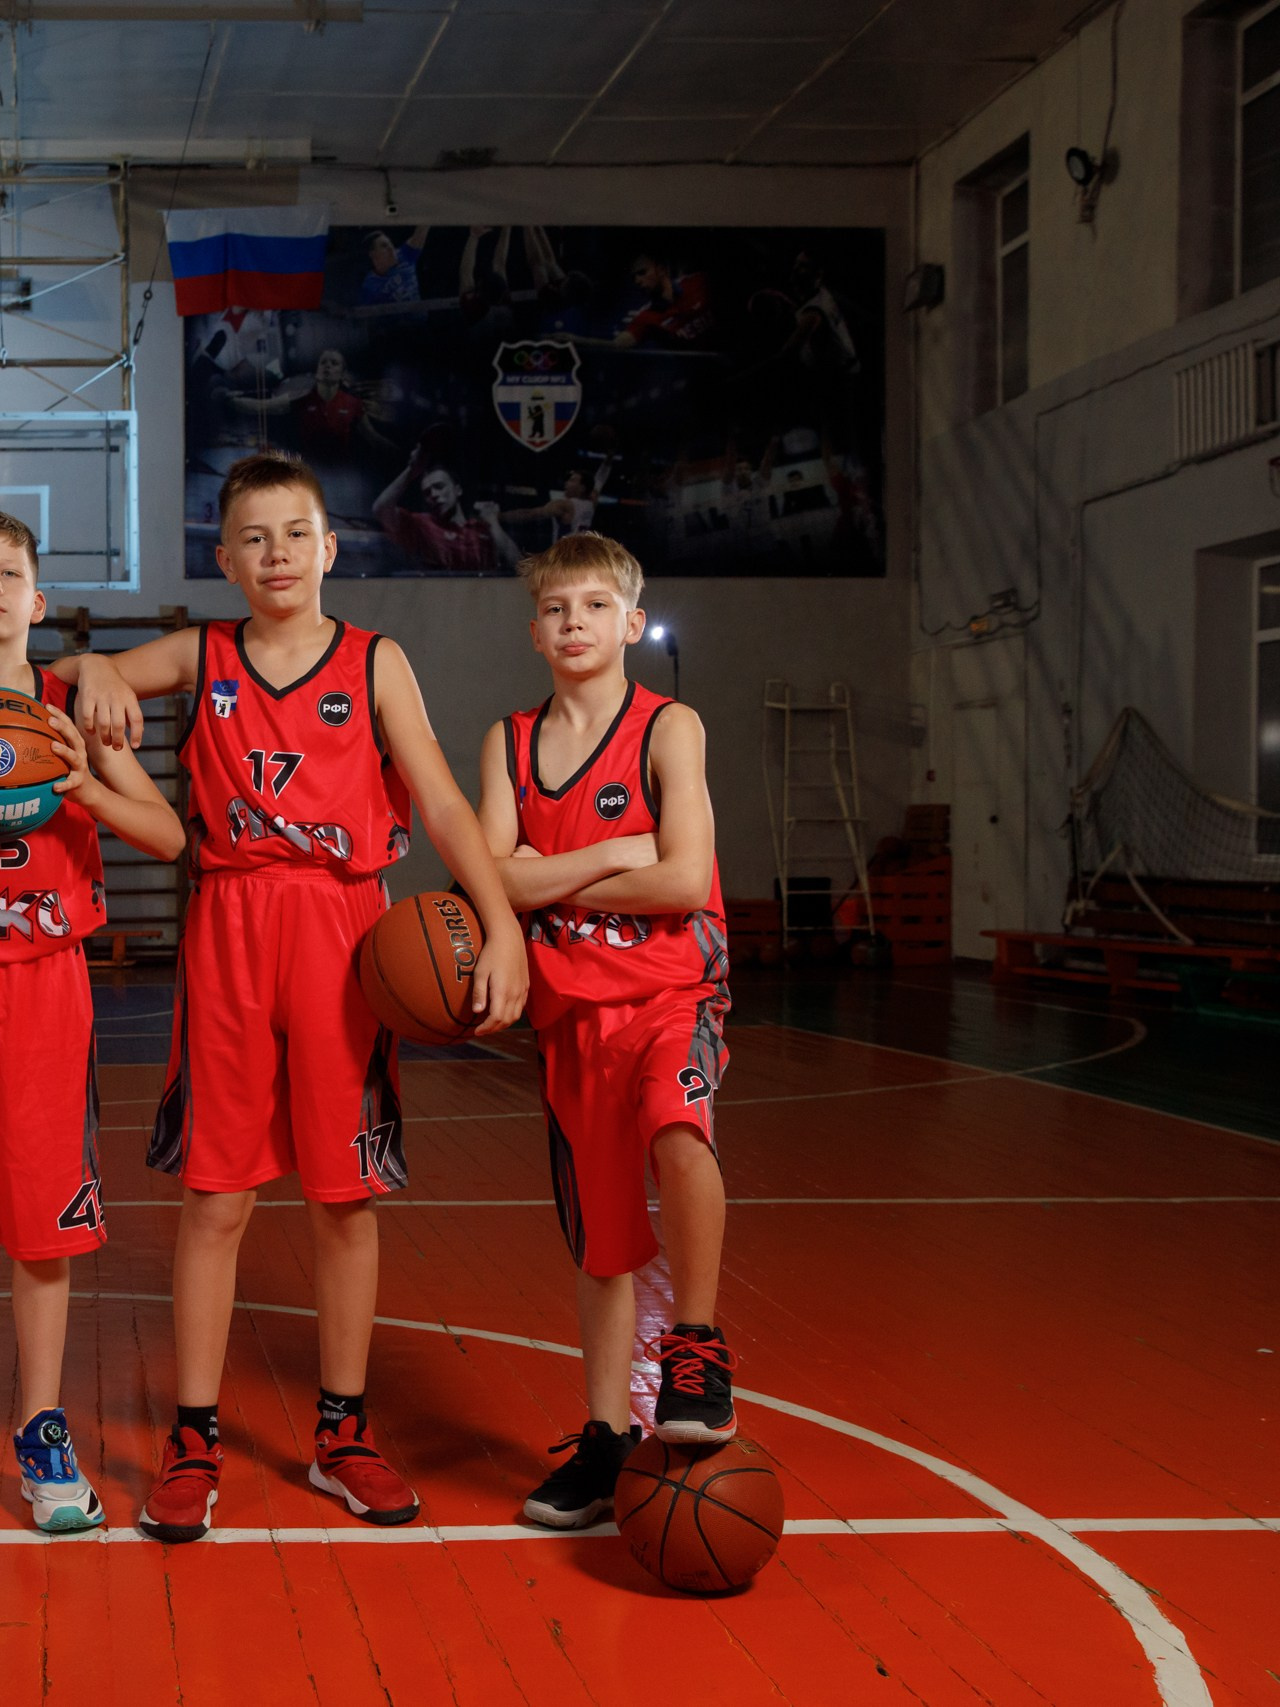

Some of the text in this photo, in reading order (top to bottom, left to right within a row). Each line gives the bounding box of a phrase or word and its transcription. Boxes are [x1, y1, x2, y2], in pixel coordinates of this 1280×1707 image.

[322, 703, 349, 714] РФБ
[242, 749, 305, 799] 17
[600, 794, 625, 808] РФБ
[226, 796, 354, 861] ЯКО
[432, 899, 476, 983] TORRES
[676, 1066, 713, 1107] 2
[349, 1121, 395, 1179] 17
[56, 1176, 105, 1231] 4
